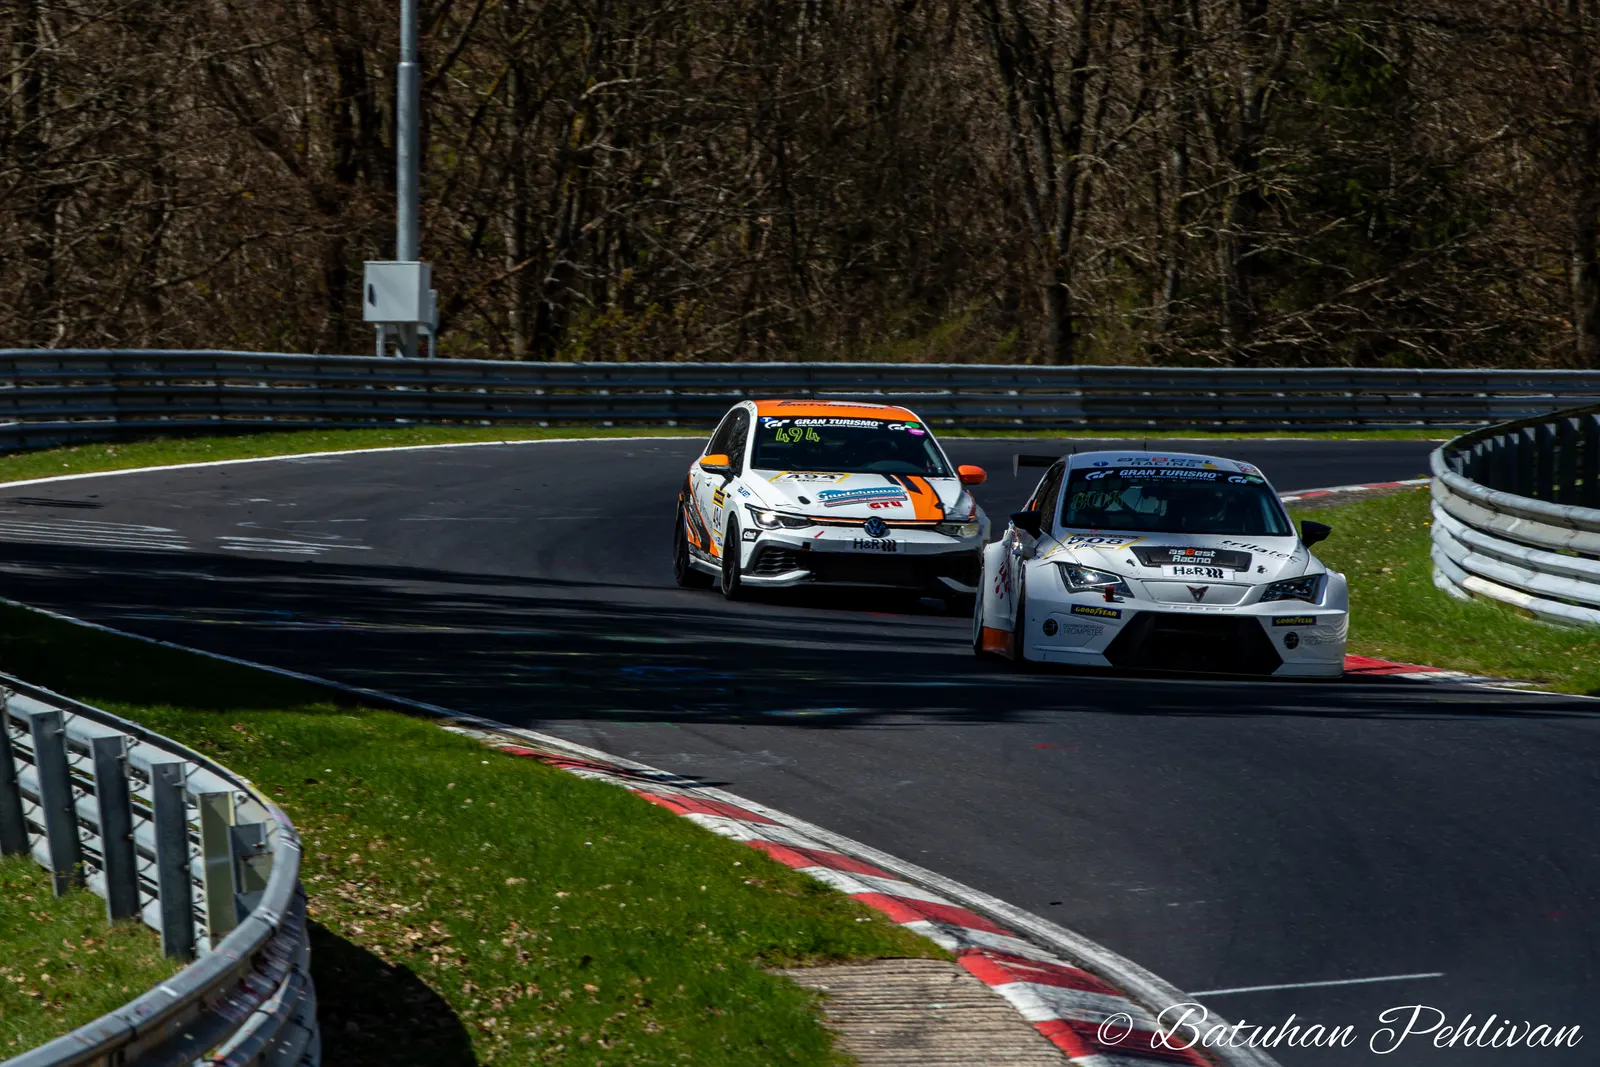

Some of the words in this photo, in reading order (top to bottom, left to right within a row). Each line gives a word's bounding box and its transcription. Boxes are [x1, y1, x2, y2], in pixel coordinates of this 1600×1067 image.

[794, 418, 827, 426] GRAN
[828, 418, 879, 427] TURISMO
[775, 427, 821, 443] 494
[1159, 469, 1218, 479] TURISMO
[853, 538, 881, 550] H&R
[1168, 548, 1216, 557] asBest
[1172, 555, 1211, 564] Racing
[1173, 566, 1205, 577] H&R
[1074, 606, 1118, 617] GOODYEAR
[1275, 616, 1313, 625] GOODYEAR
